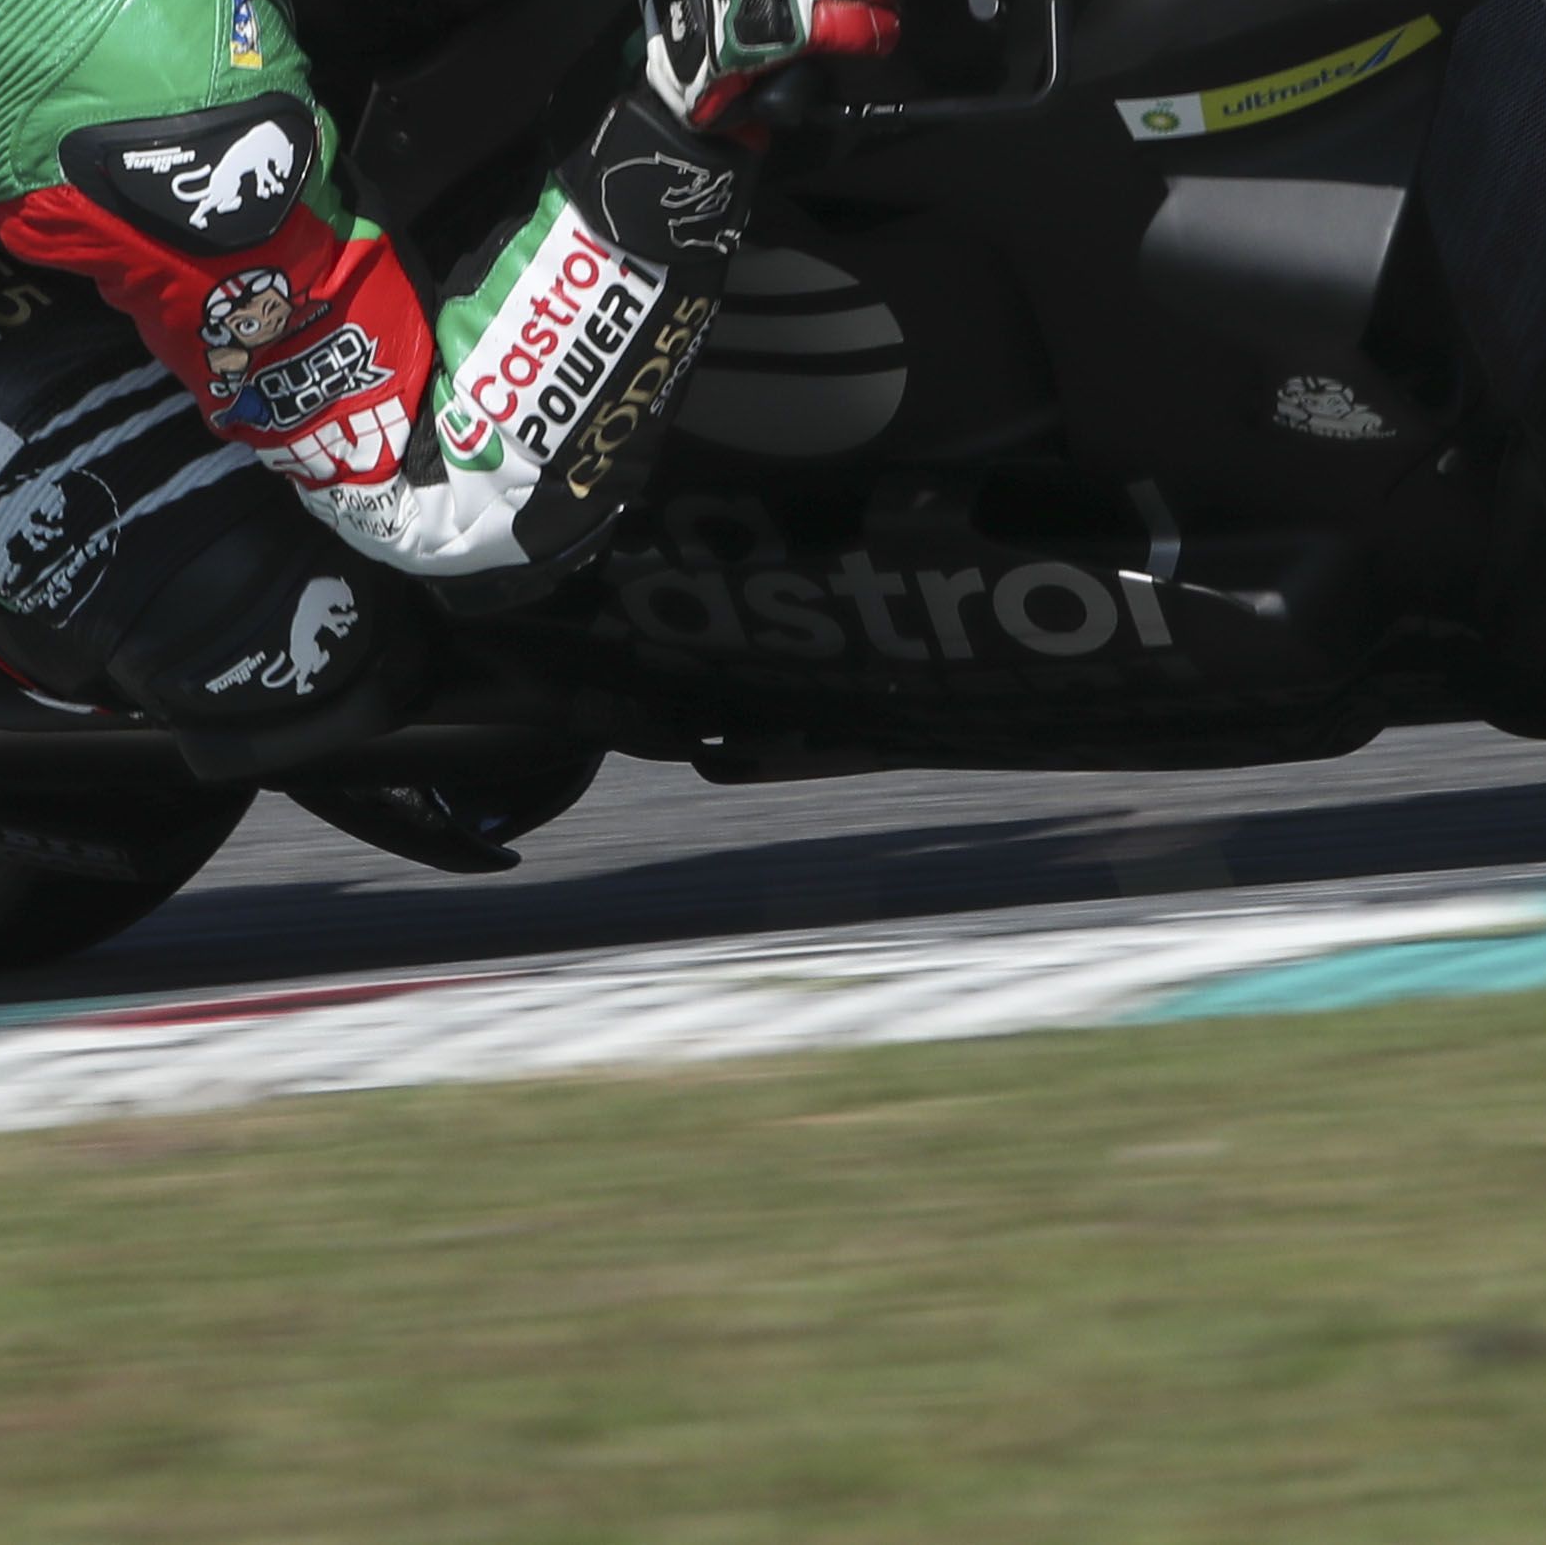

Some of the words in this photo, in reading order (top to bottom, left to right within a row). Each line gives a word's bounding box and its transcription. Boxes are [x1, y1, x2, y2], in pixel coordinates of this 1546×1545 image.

[1222, 61, 1355, 116] ultimate
[472, 228, 611, 423] Castrol
[261, 333, 364, 398] QUAD
[271, 362, 394, 424] LOCK
[595, 550, 1174, 660] astrol
